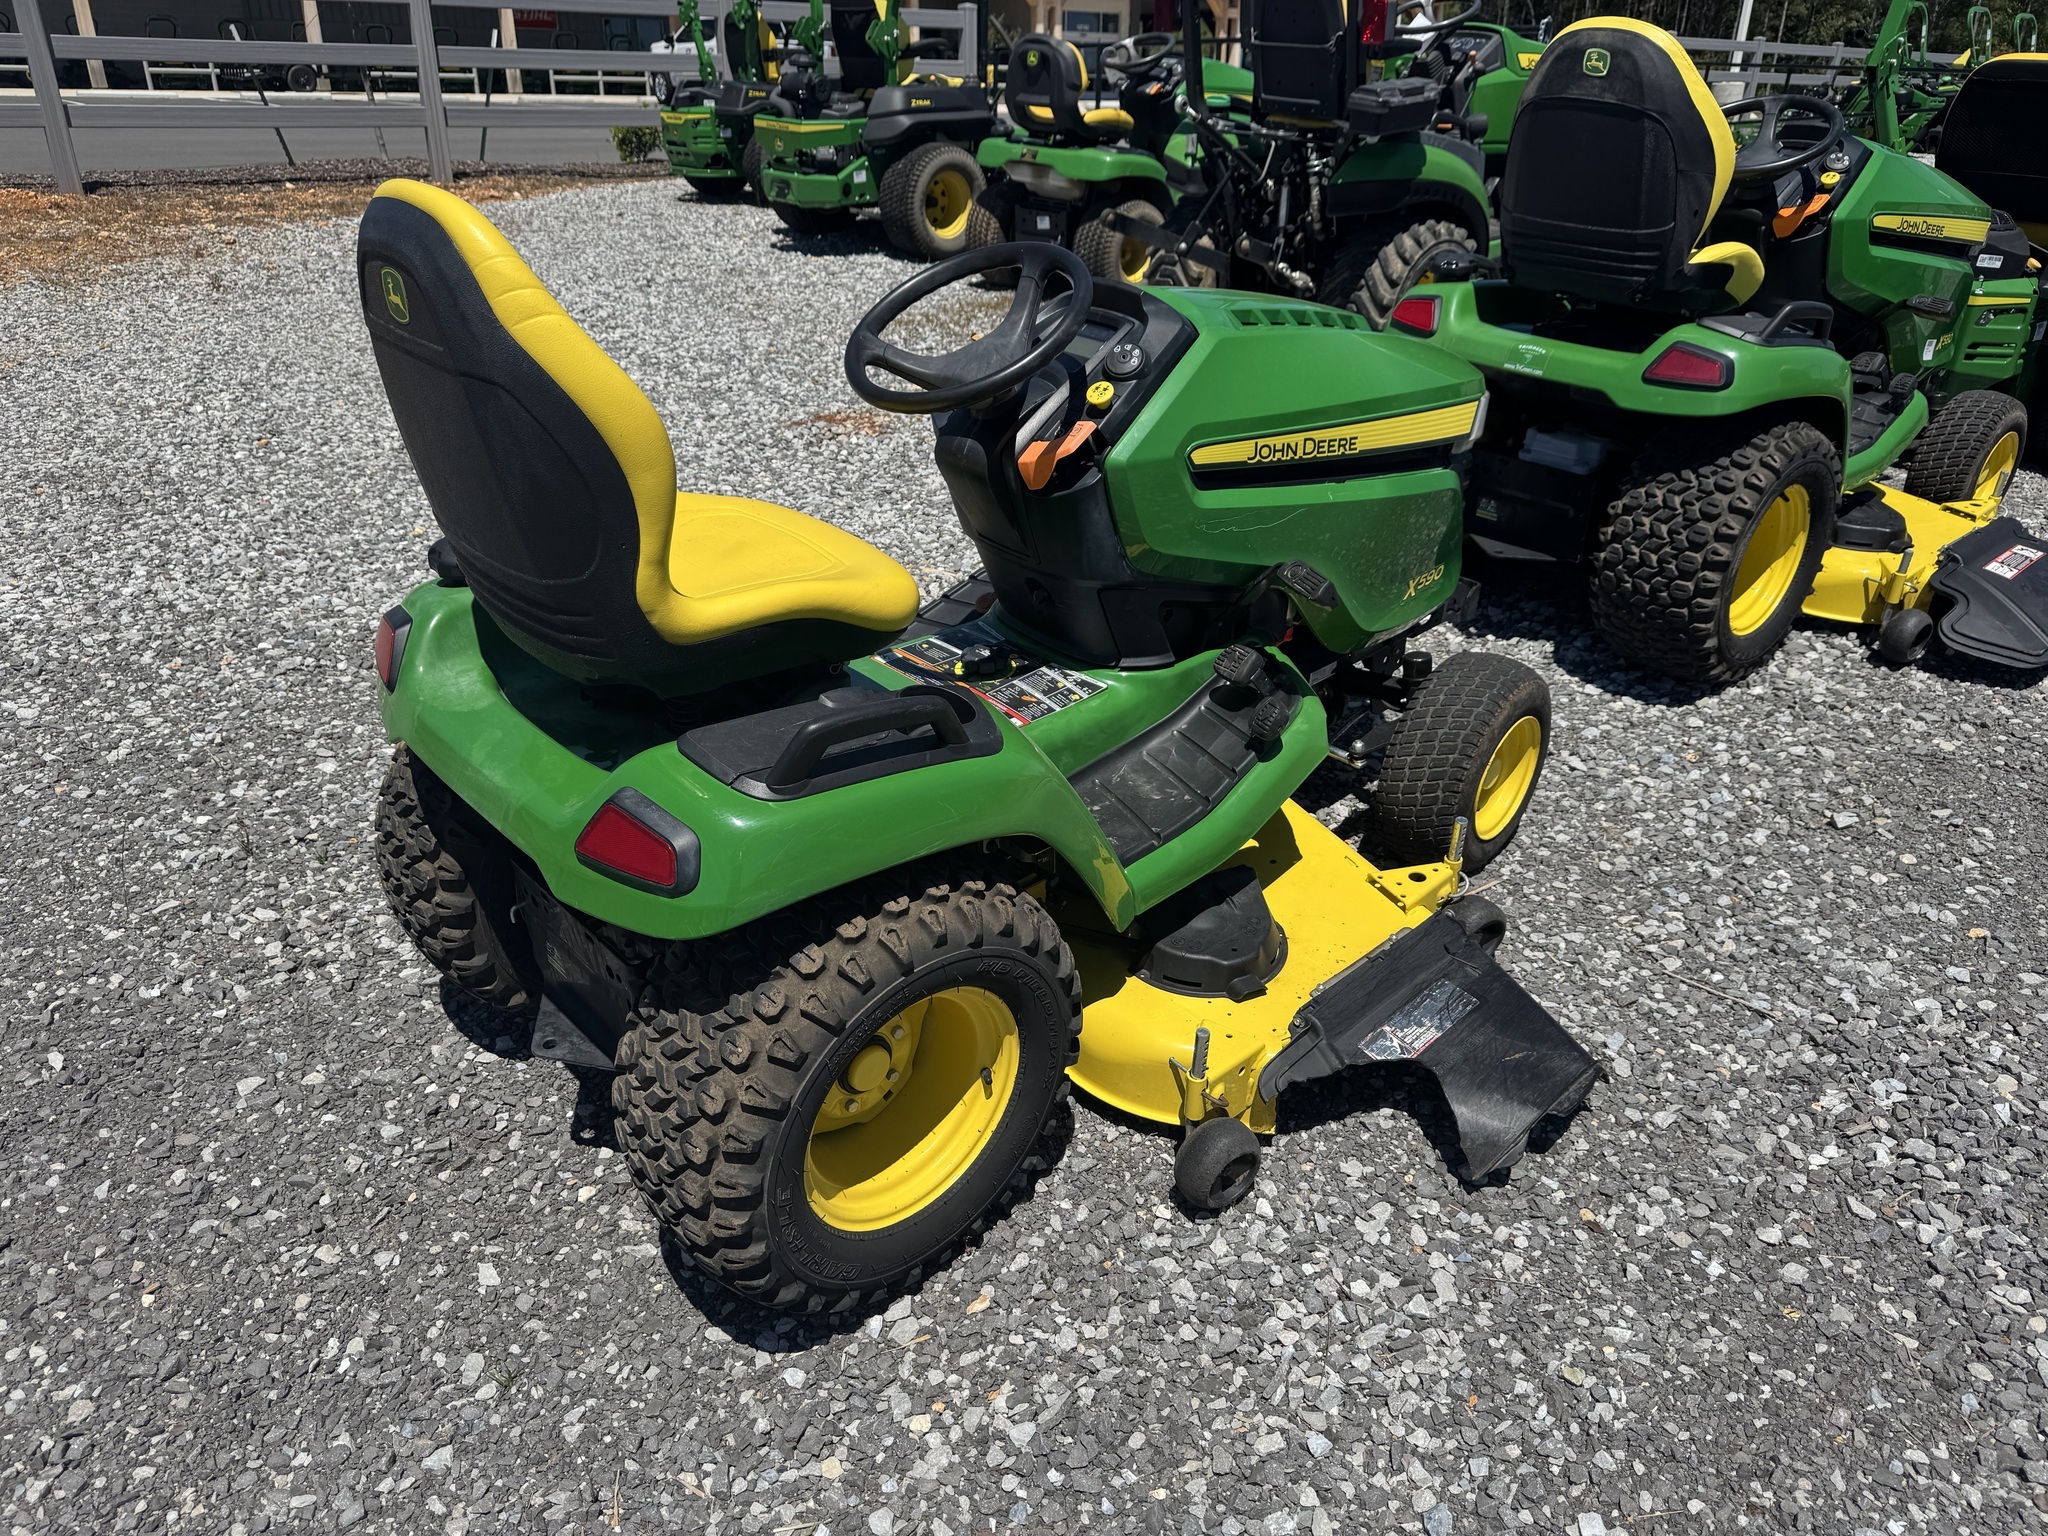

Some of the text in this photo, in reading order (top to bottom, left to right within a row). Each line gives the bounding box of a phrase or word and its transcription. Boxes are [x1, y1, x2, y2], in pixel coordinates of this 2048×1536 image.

[1896, 217, 1946, 238] JOHN DEERE
[1247, 436, 1359, 463] JOHN DEERE
[1402, 564, 1445, 601] X590
[777, 1183, 862, 1280] CARLISLE
